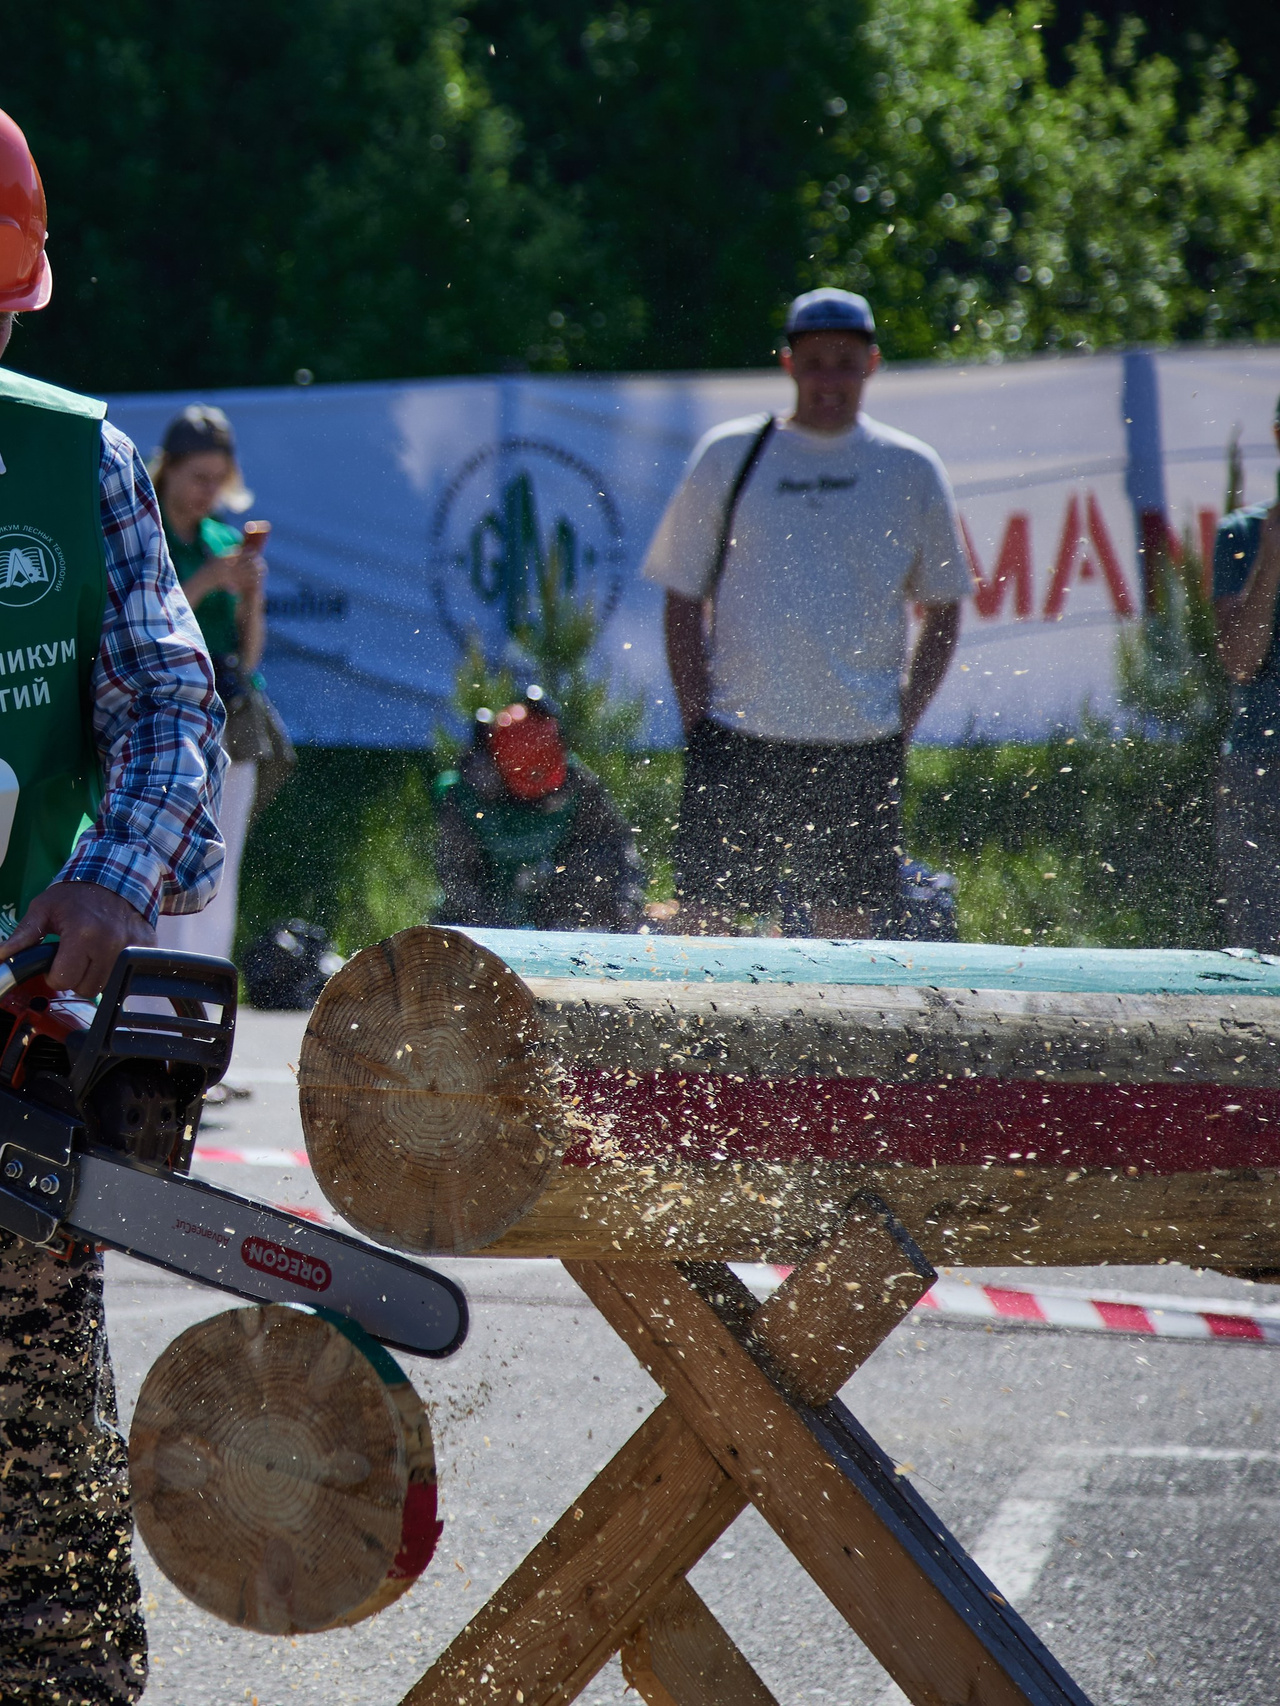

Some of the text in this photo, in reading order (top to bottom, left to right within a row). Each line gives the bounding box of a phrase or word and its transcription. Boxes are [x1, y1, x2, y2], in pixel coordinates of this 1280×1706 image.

[22, 525, 54, 544] ЛЕСНЫХ
[52, 543, 67, 592] ТЕХНОЛОГИЙ
[249, 1242, 327, 1286] OREGON
